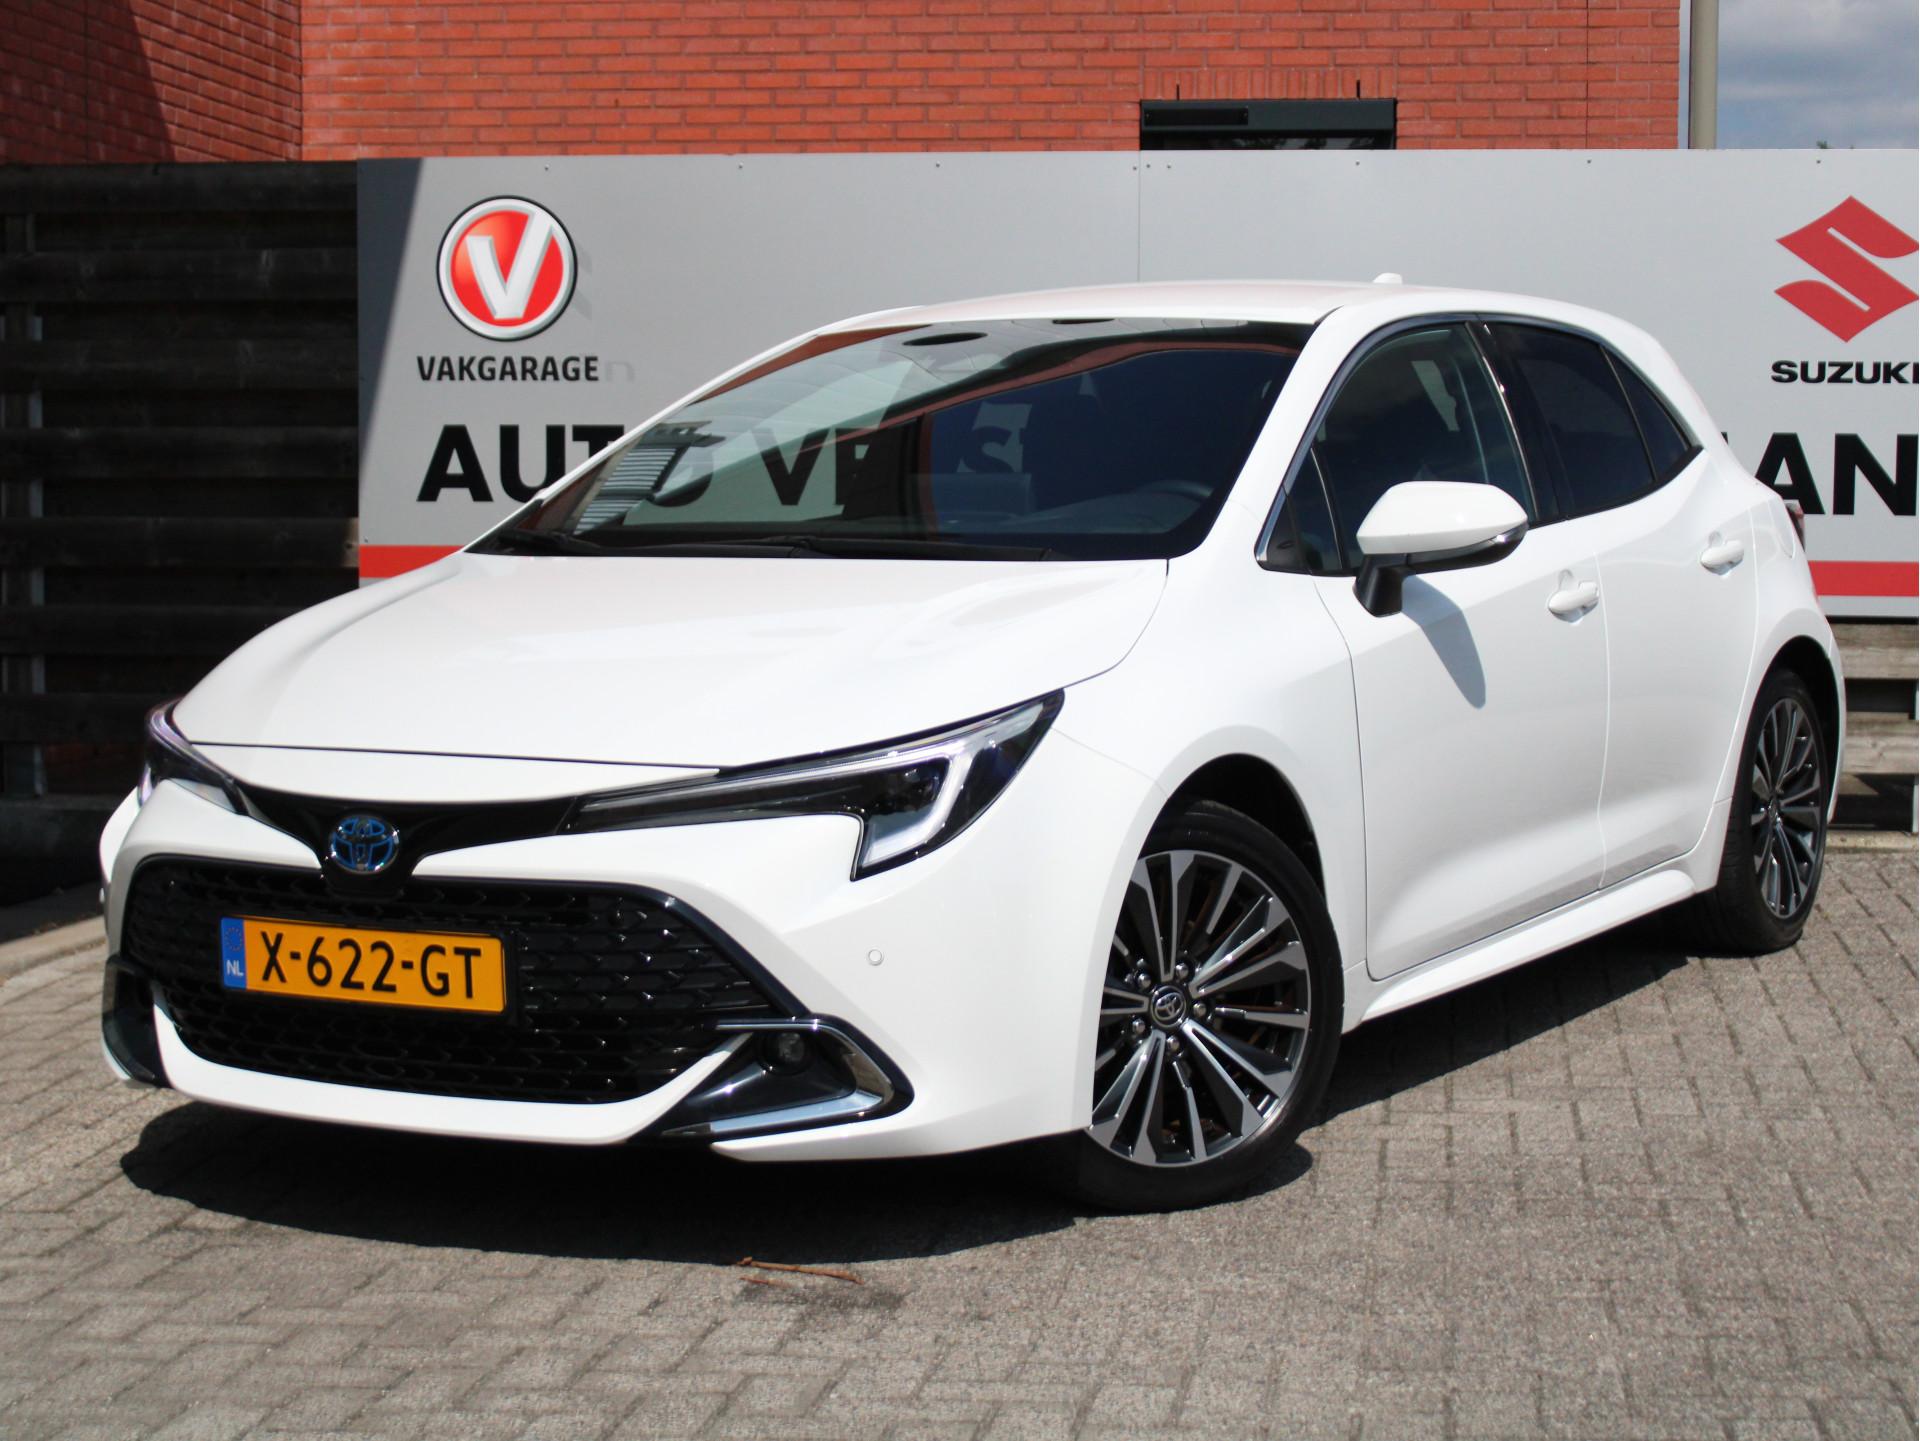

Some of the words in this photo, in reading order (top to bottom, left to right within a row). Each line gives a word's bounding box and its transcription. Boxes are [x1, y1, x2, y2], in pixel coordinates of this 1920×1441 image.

[416, 355, 600, 382] VAKGARAGE
[1771, 359, 1919, 384] SUZUKI
[226, 959, 244, 978] NL
[260, 930, 482, 999] X-622-GT
